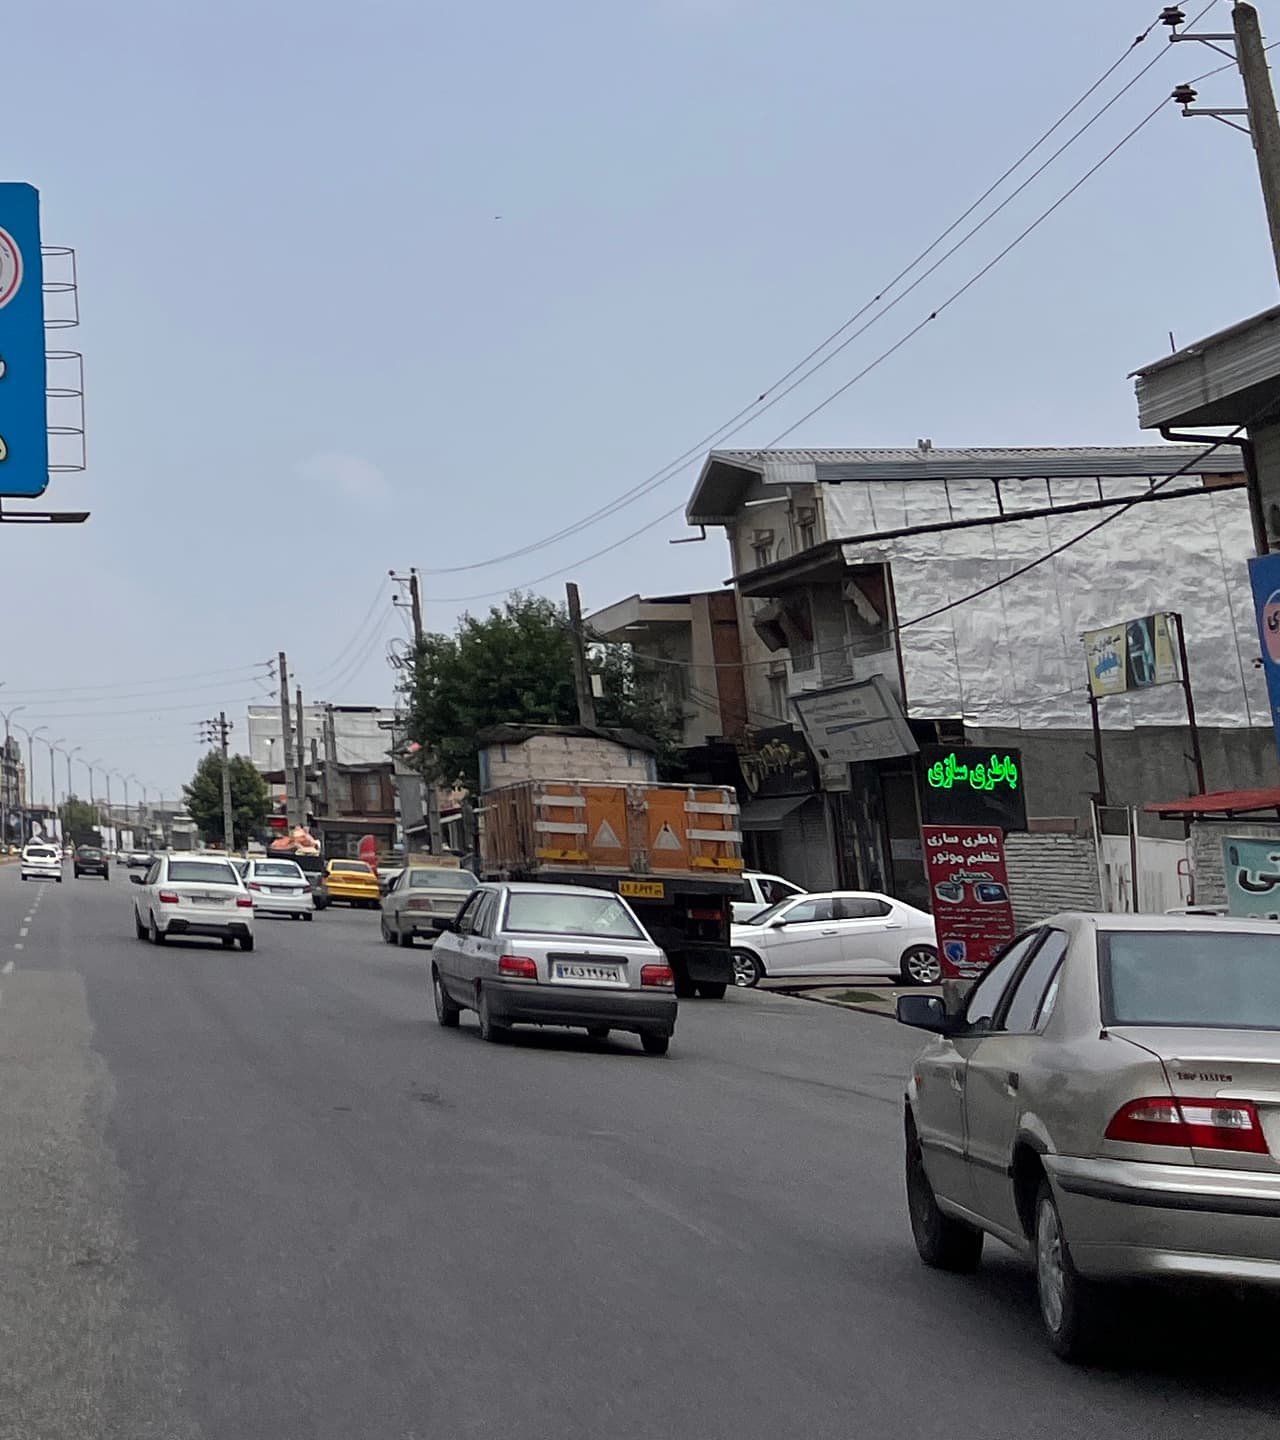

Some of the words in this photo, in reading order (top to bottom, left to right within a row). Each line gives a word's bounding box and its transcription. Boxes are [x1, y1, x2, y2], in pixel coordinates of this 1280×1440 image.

[928, 753, 968, 788] سازی
[970, 754, 1017, 790] باطری
[962, 833, 998, 848] باطری
[932, 850, 965, 865] موتور
[966, 850, 1000, 867] تنظیم
